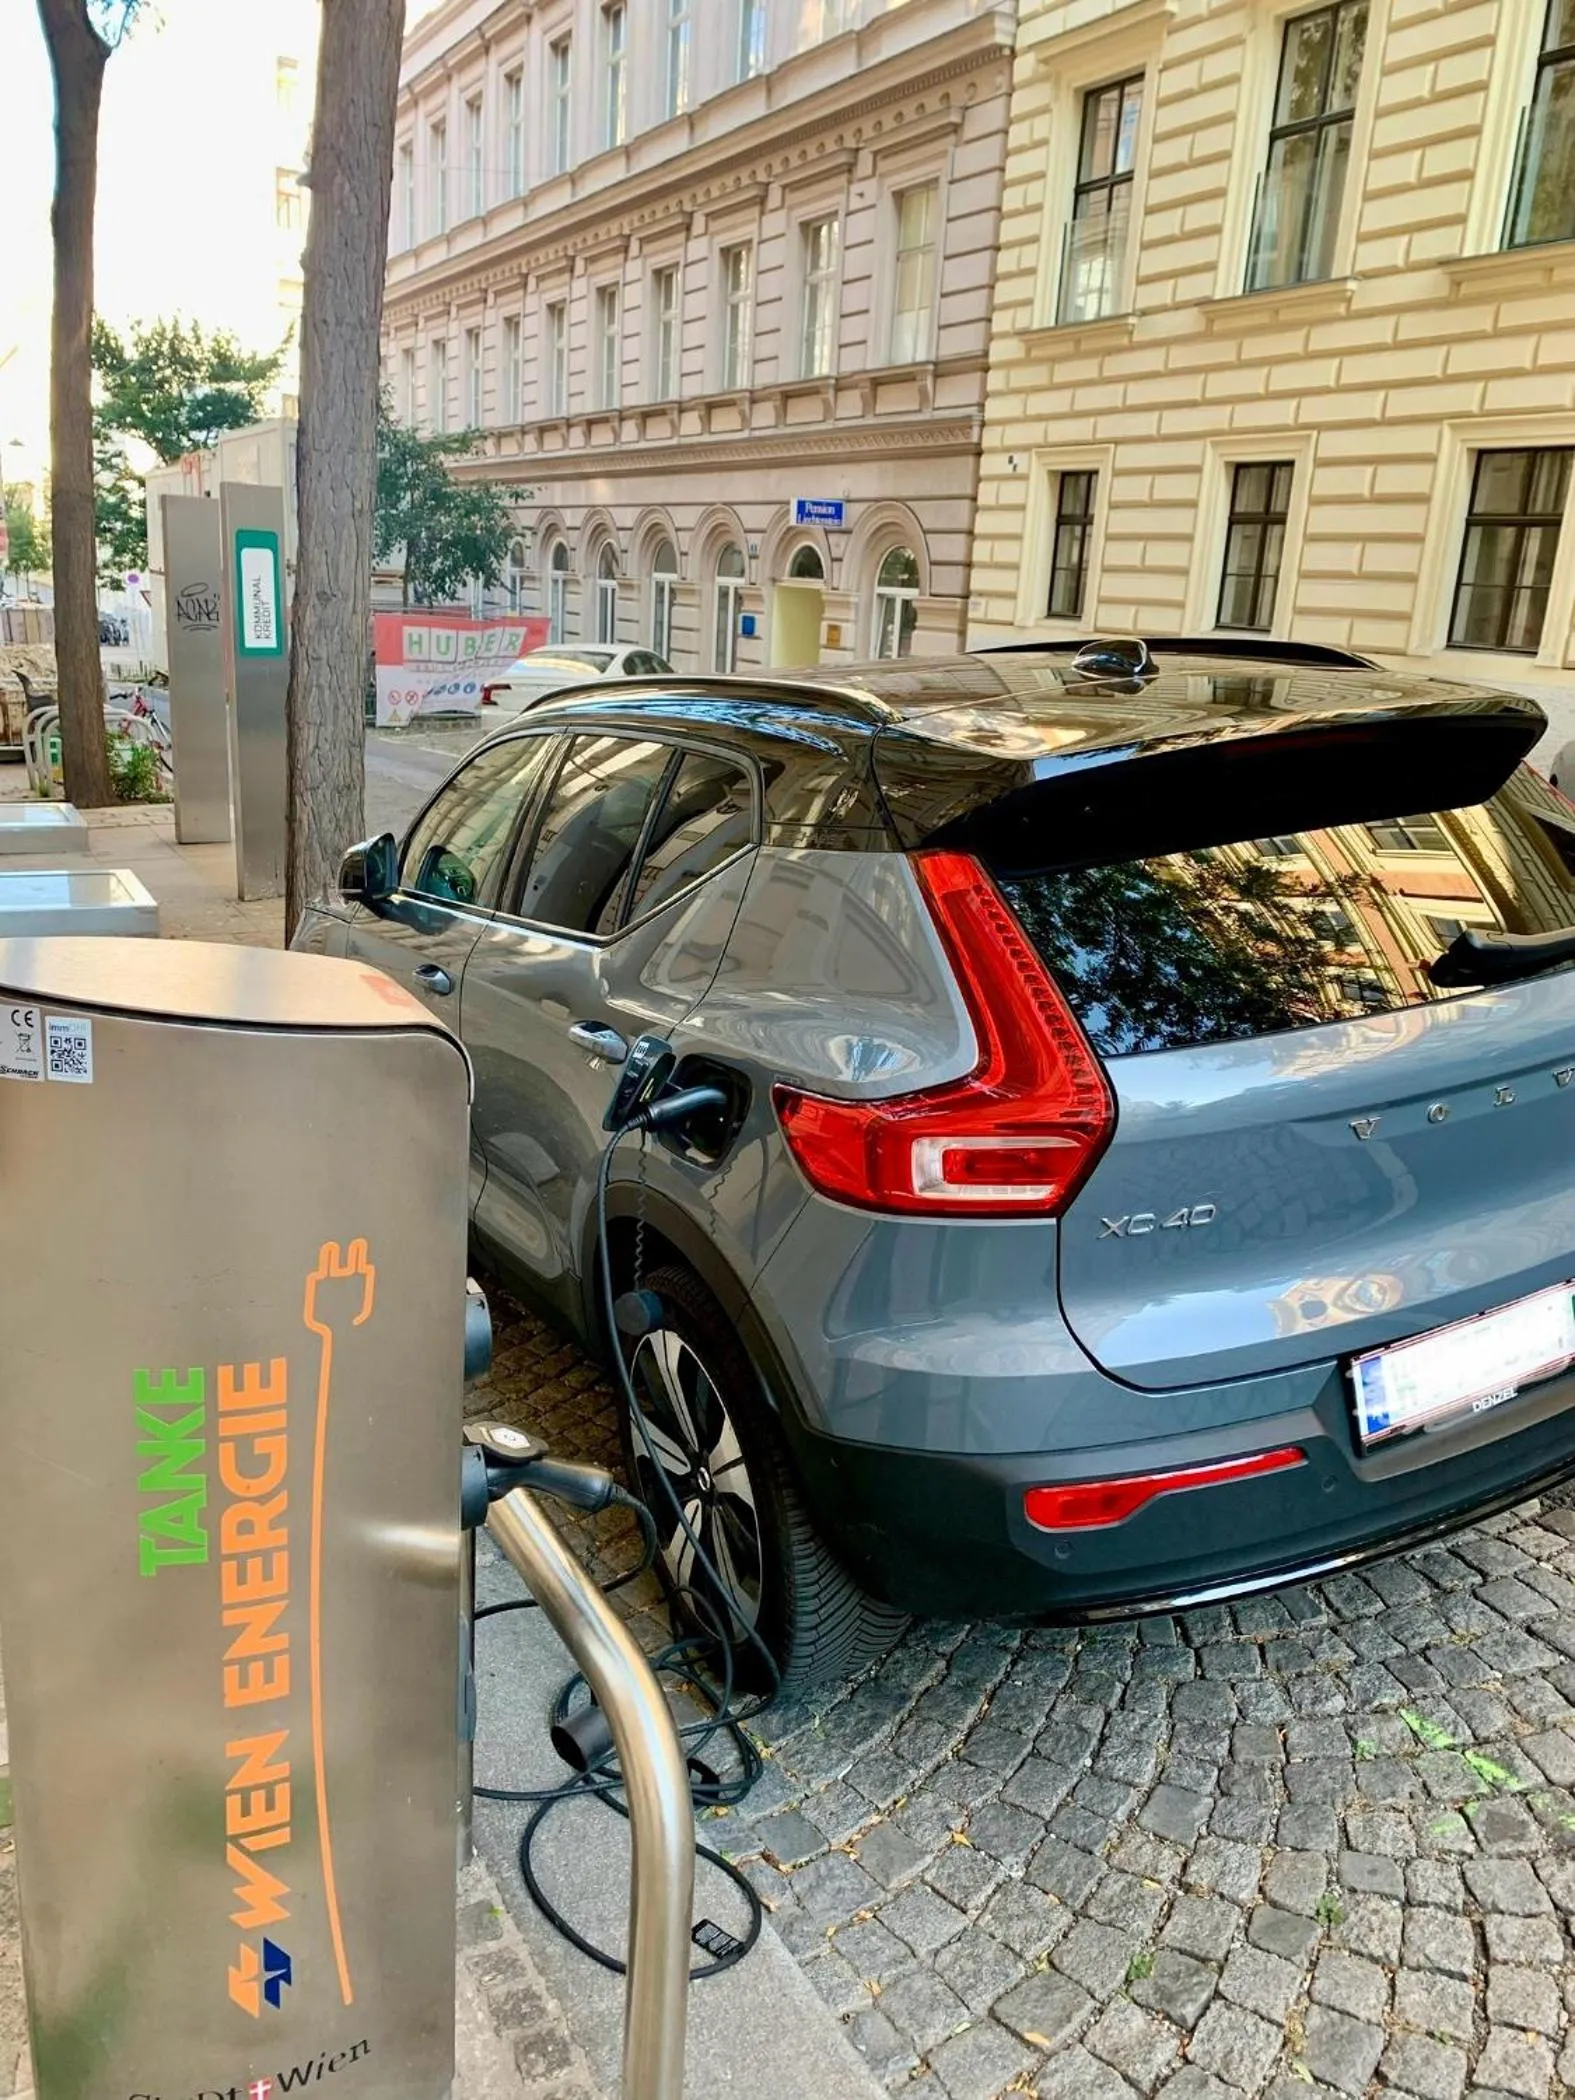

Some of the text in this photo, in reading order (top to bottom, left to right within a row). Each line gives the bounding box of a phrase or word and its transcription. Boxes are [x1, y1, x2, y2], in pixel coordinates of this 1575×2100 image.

[251, 574, 263, 640] KOMMUNAL
[262, 601, 273, 640] KREDIT
[406, 631, 522, 657] HUBER
[1472, 1386, 1518, 1413] DENZEL
[133, 1367, 208, 1576] TANKE
[217, 1356, 291, 1930] WIEN ENERGIE
[276, 2038, 371, 2093] Wien
